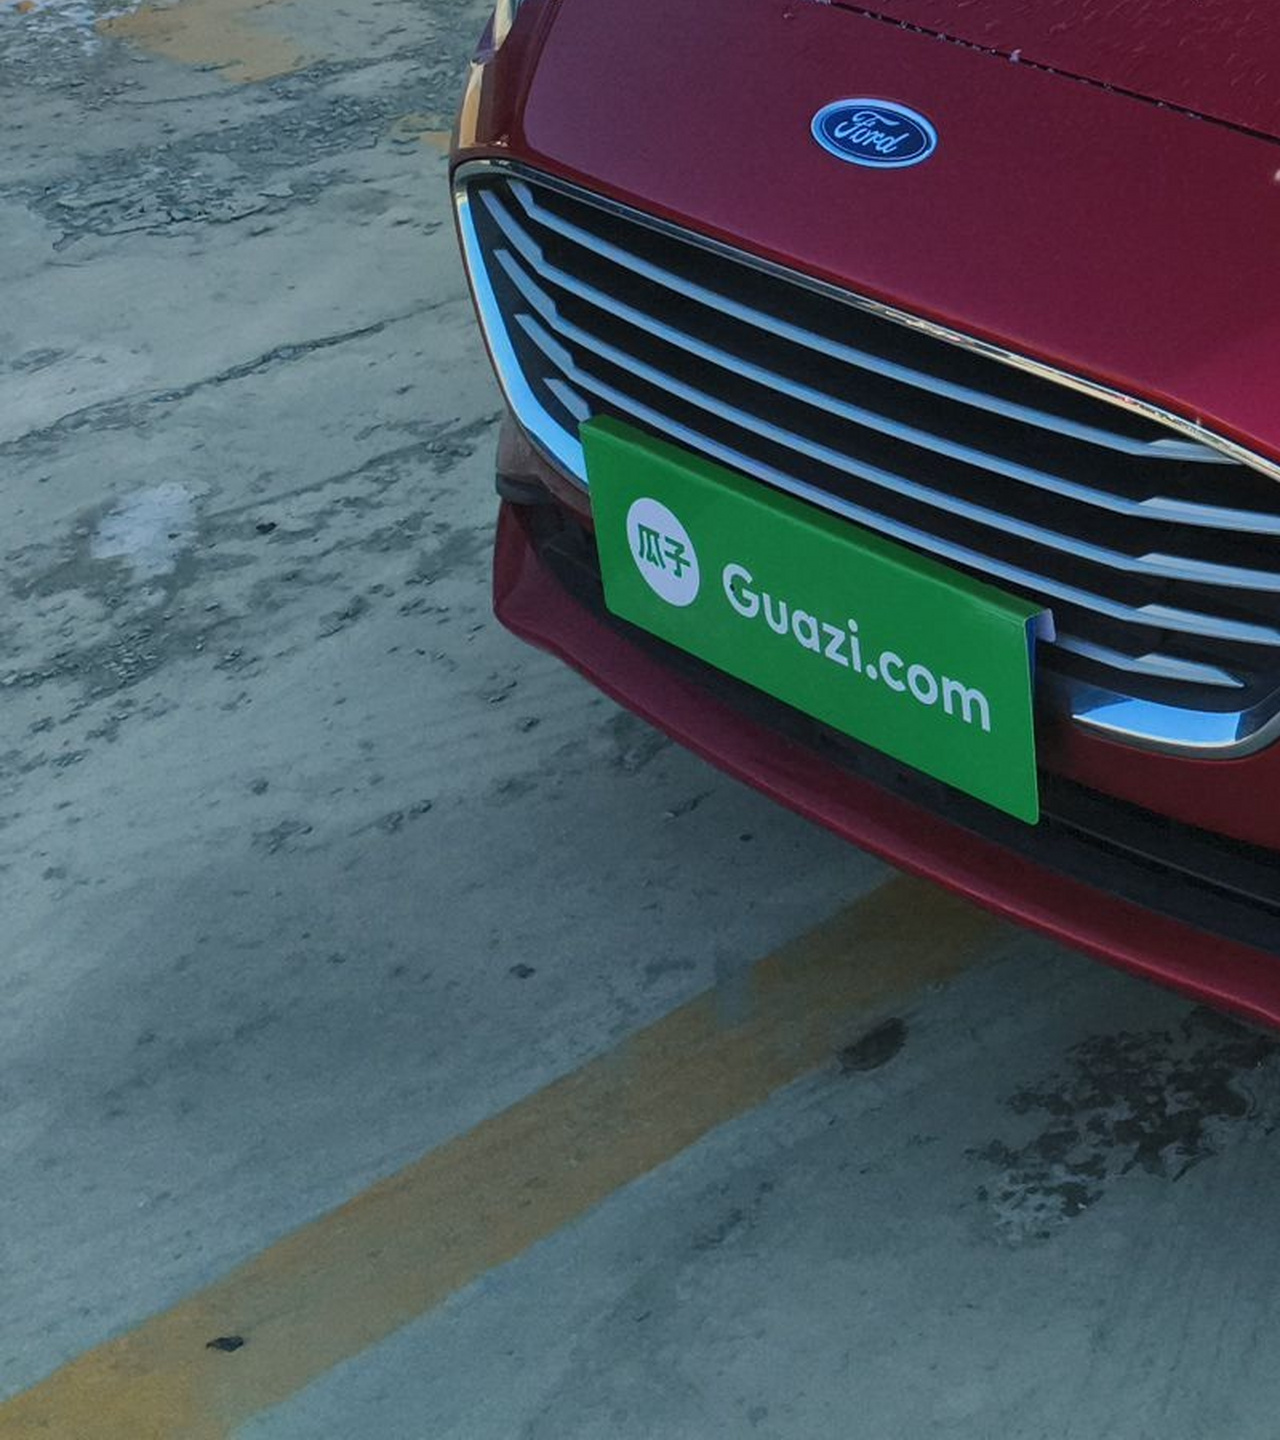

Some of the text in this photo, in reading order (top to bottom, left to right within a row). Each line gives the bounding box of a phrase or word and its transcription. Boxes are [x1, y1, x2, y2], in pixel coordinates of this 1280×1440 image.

[834, 110, 909, 153] Ford
[637, 523, 691, 578] 瓜子
[722, 563, 991, 732] Guazi.com
